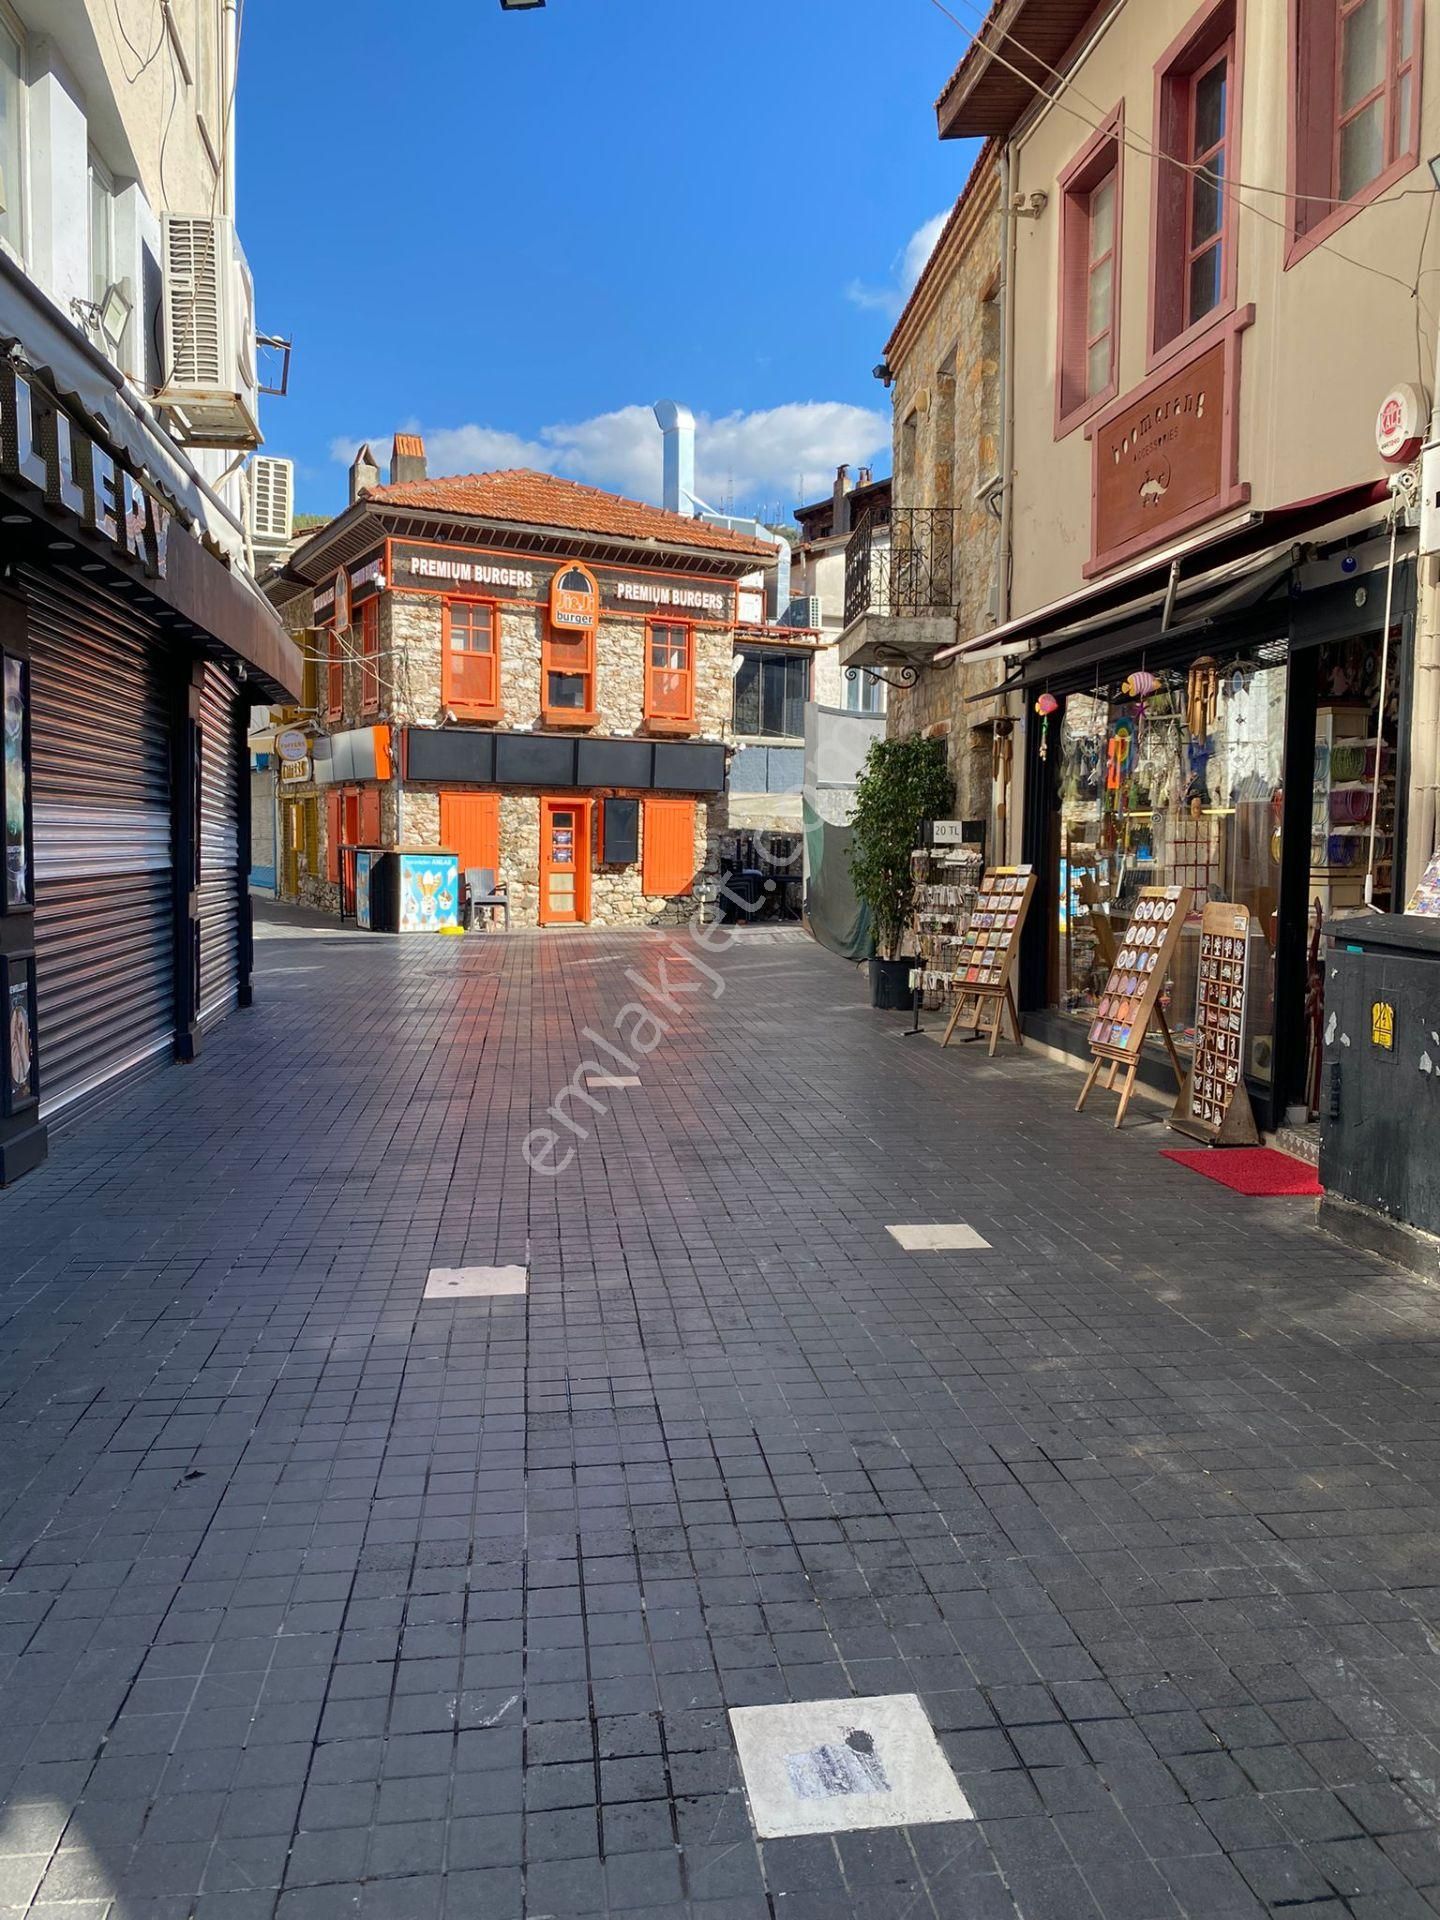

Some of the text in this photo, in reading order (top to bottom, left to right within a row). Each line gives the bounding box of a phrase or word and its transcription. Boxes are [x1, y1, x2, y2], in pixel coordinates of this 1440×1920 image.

[1111, 391, 1206, 465] boomerang
[0, 373, 171, 580] LLERY
[410, 556, 472, 582] PREMIUM
[473, 564, 534, 589] BURGERS
[616, 582, 724, 611] PREMIUM BURGERS
[556, 610, 594, 624] burger
[935, 825, 960, 836] 20 TL
